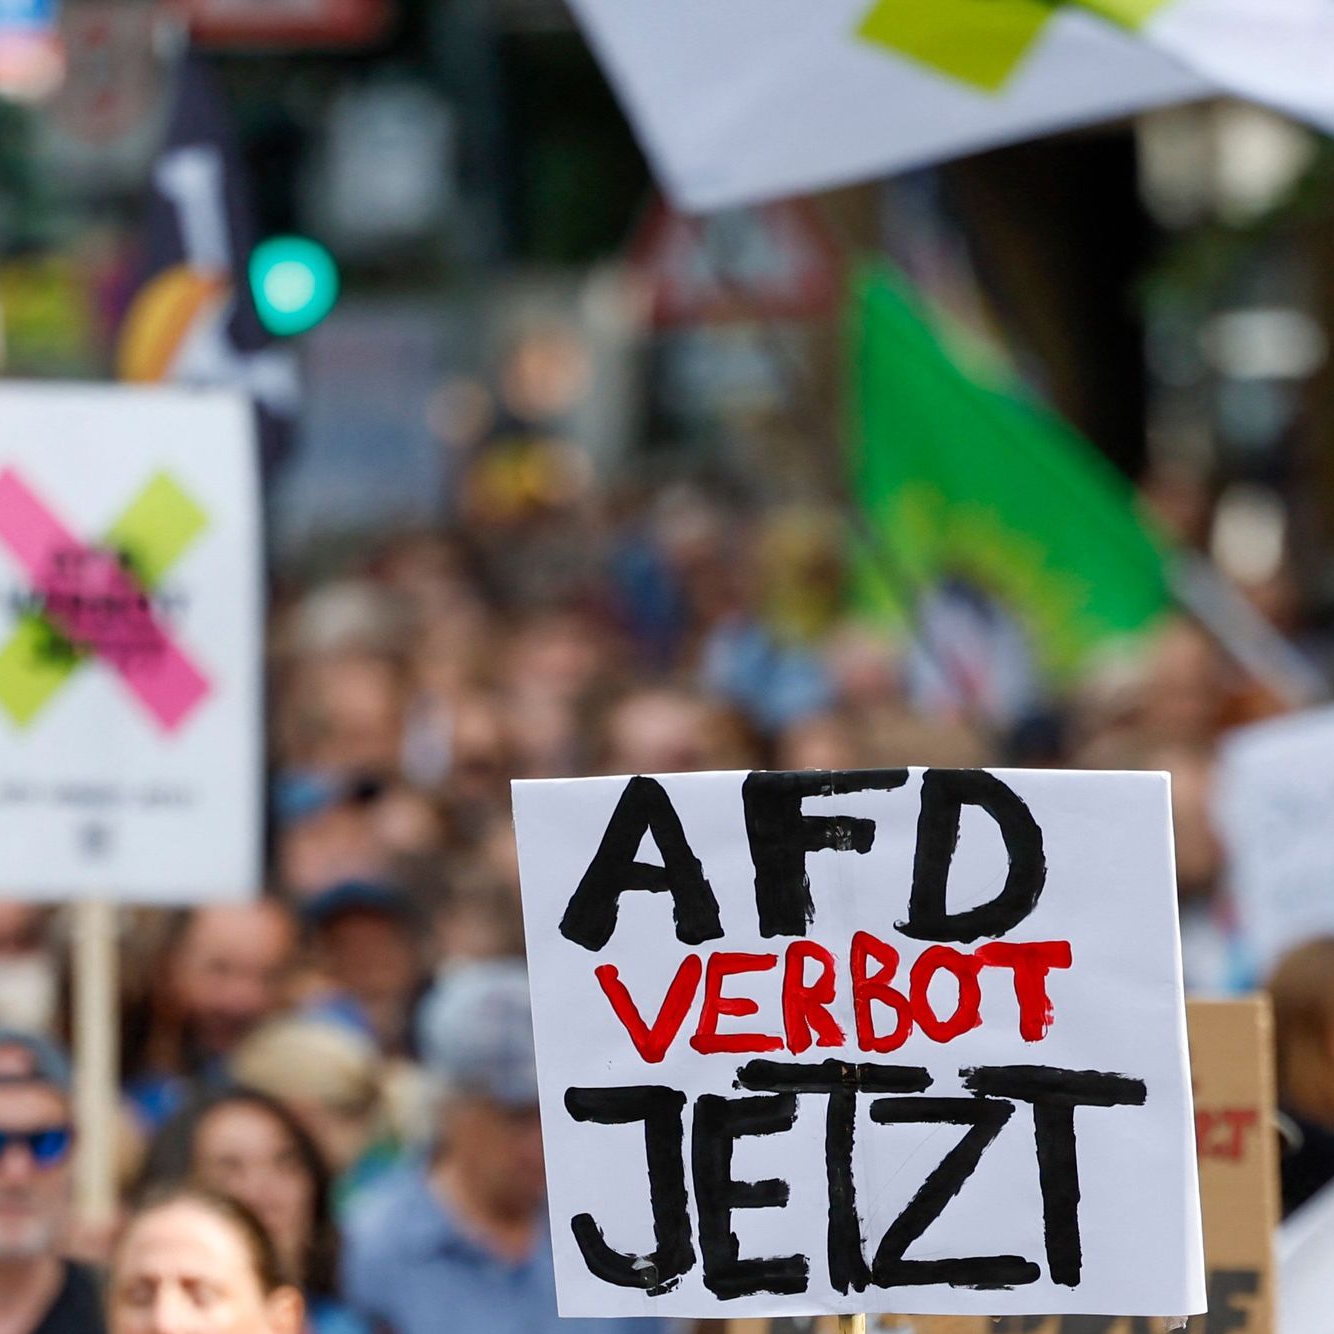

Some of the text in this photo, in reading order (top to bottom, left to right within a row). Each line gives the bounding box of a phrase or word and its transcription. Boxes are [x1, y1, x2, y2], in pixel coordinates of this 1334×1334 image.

[559, 769, 1047, 951] AFD
[594, 930, 1072, 1063] VERBOT
[564, 1058, 1147, 1300] JETZT
